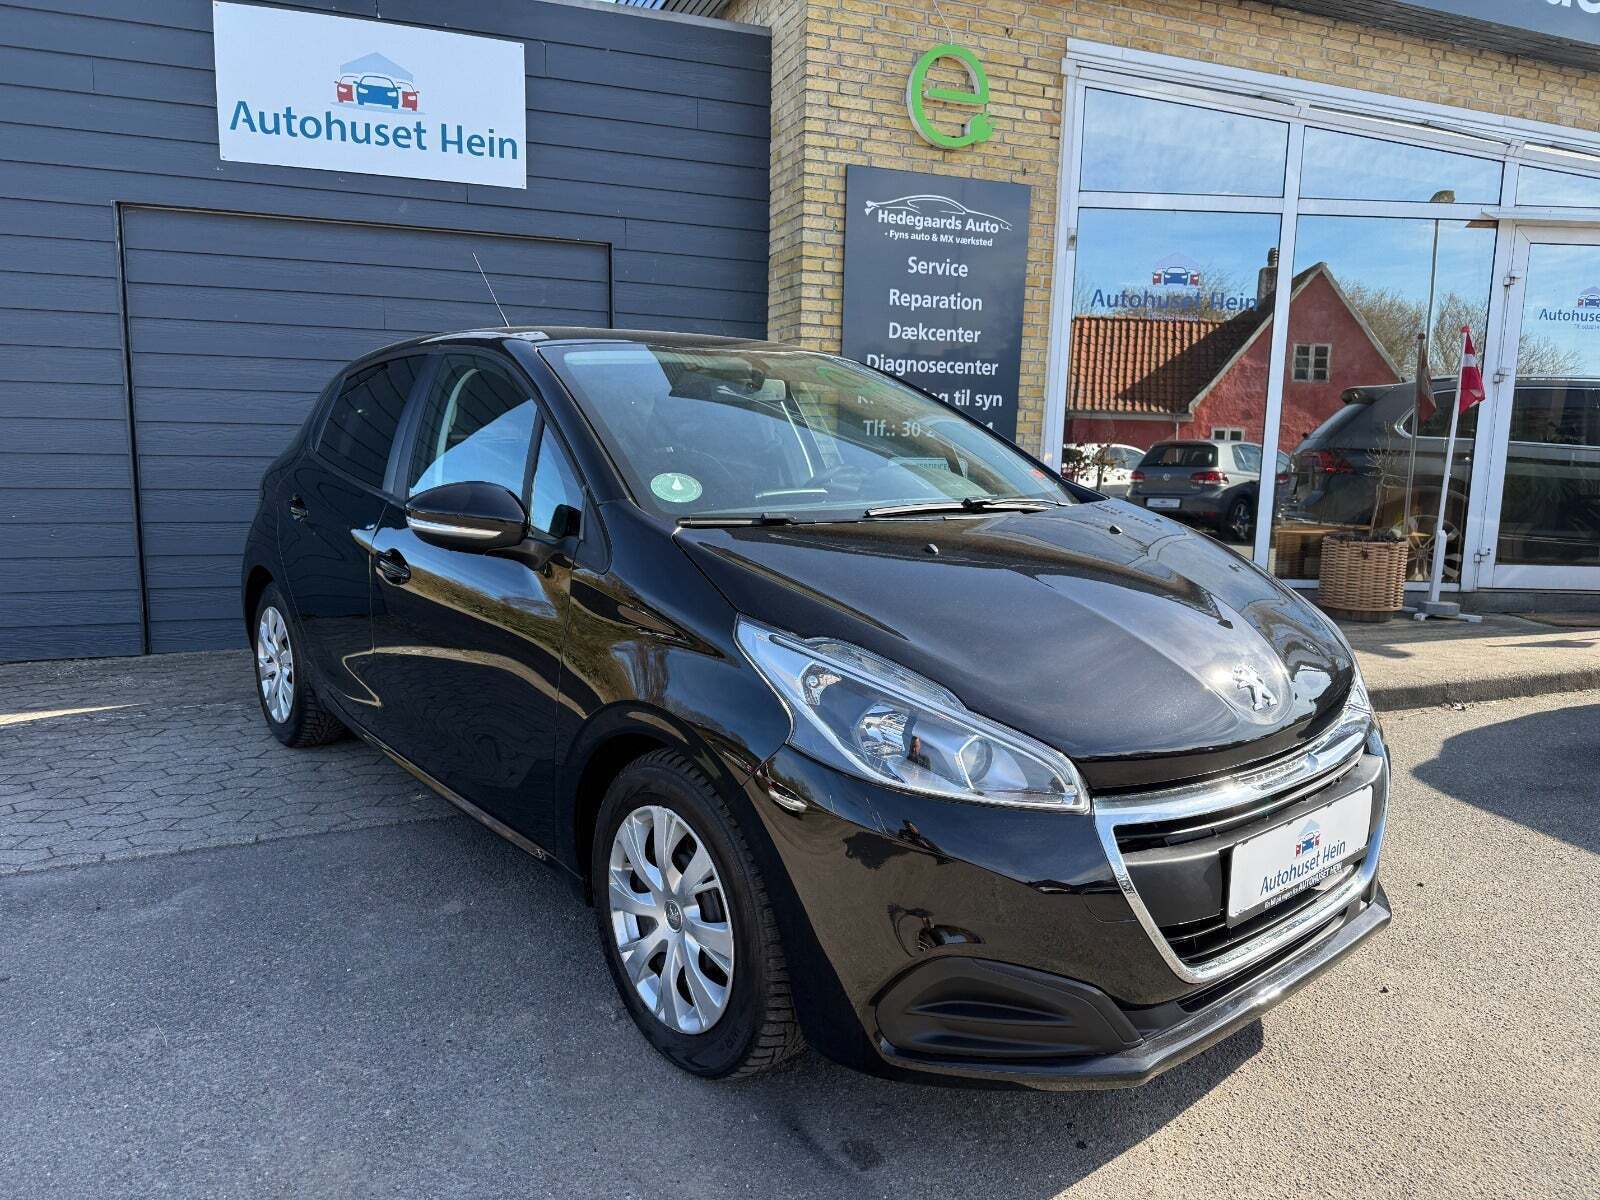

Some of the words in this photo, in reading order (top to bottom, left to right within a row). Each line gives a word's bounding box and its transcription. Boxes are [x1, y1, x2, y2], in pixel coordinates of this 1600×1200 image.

[229, 100, 427, 150] Autohuset
[440, 123, 518, 160] Hein
[877, 209, 962, 230] Hedegaards
[964, 218, 999, 233] Auto
[889, 229, 910, 241] Fyns
[910, 233, 930, 241] auto
[931, 233, 938, 242] &
[939, 234, 954, 243] MX
[955, 236, 993, 247] værksted
[907, 256, 969, 278] Service
[889, 288, 983, 311] Reparation
[1090, 288, 1200, 309] Autohuset
[1211, 291, 1258, 311] Hein
[888, 322, 981, 343] Dækcenter
[866, 354, 999, 376] Diagnosecenter
[953, 389, 971, 406] til
[974, 393, 1003, 410] syn
[863, 419, 896, 437] Tlf.:
[901, 421, 921, 437] 30
[1260, 850, 1320, 896] Autohuset
[1322, 840, 1346, 863] Hein
